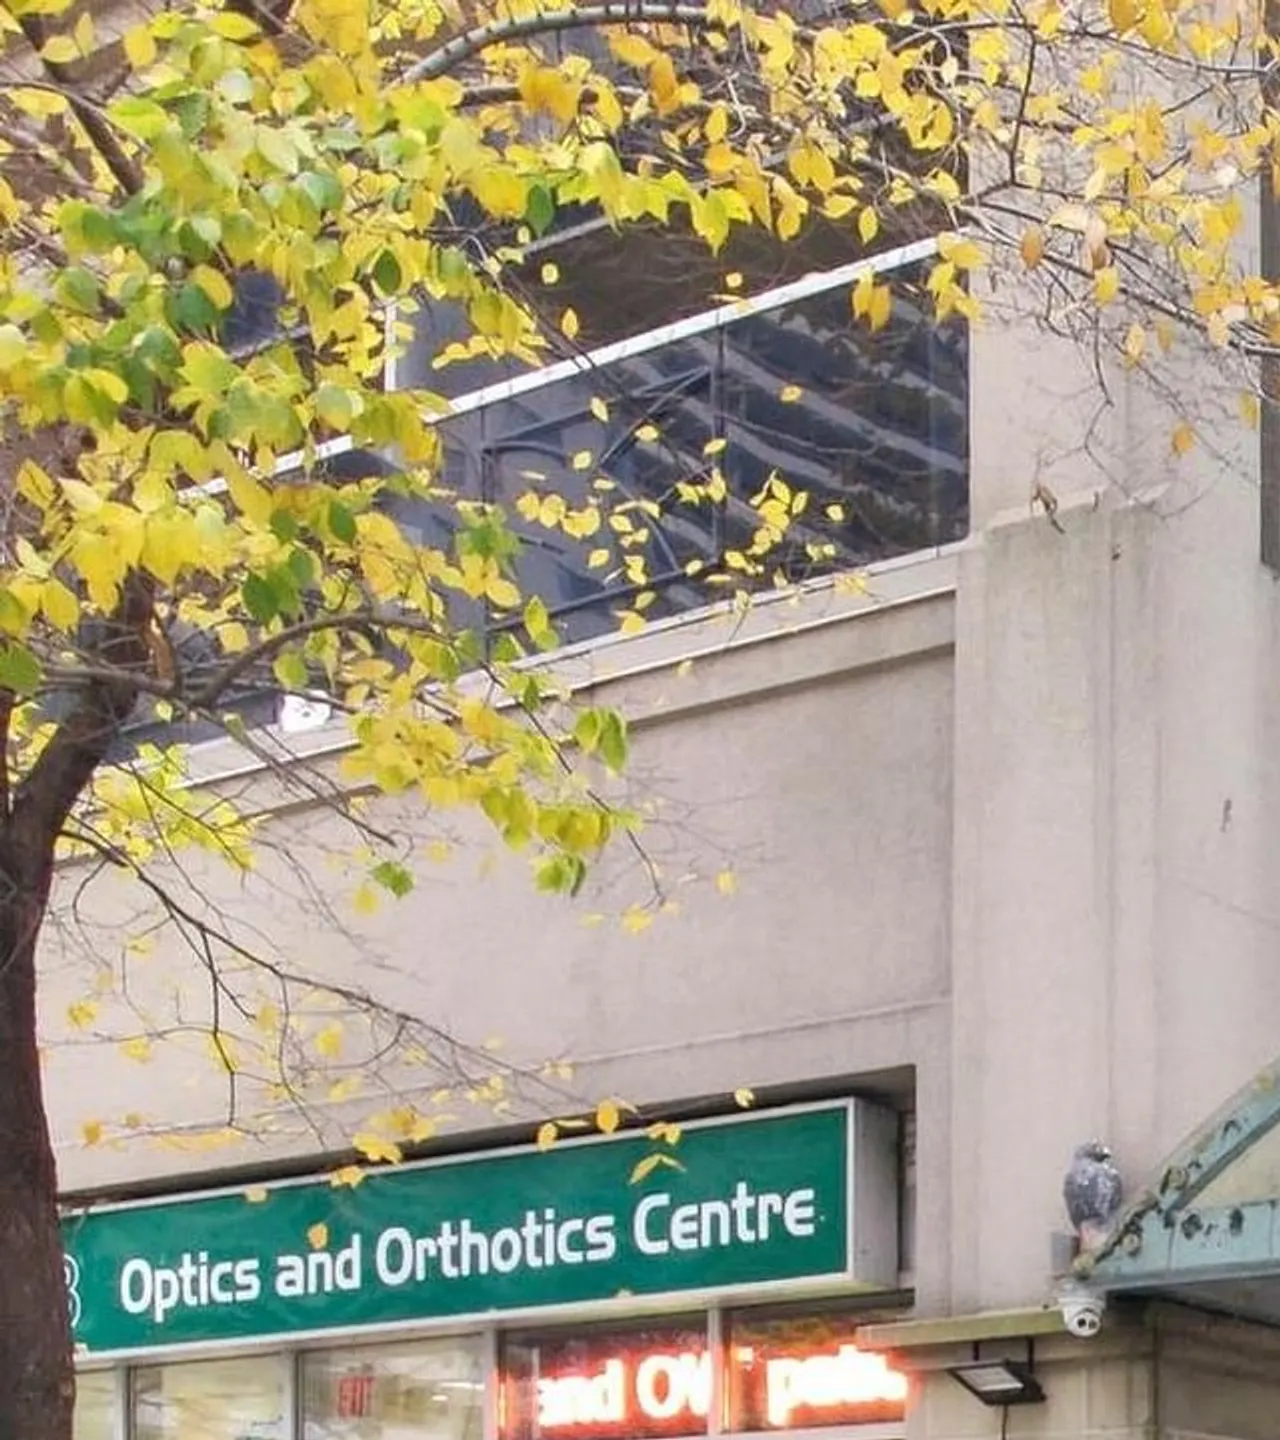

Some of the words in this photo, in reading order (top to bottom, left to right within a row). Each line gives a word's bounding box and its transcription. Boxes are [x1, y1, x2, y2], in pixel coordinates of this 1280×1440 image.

[119, 1251, 260, 1323] Optics
[275, 1234, 361, 1297] and
[376, 1208, 616, 1286] Orthotics
[633, 1182, 815, 1254] Centre
